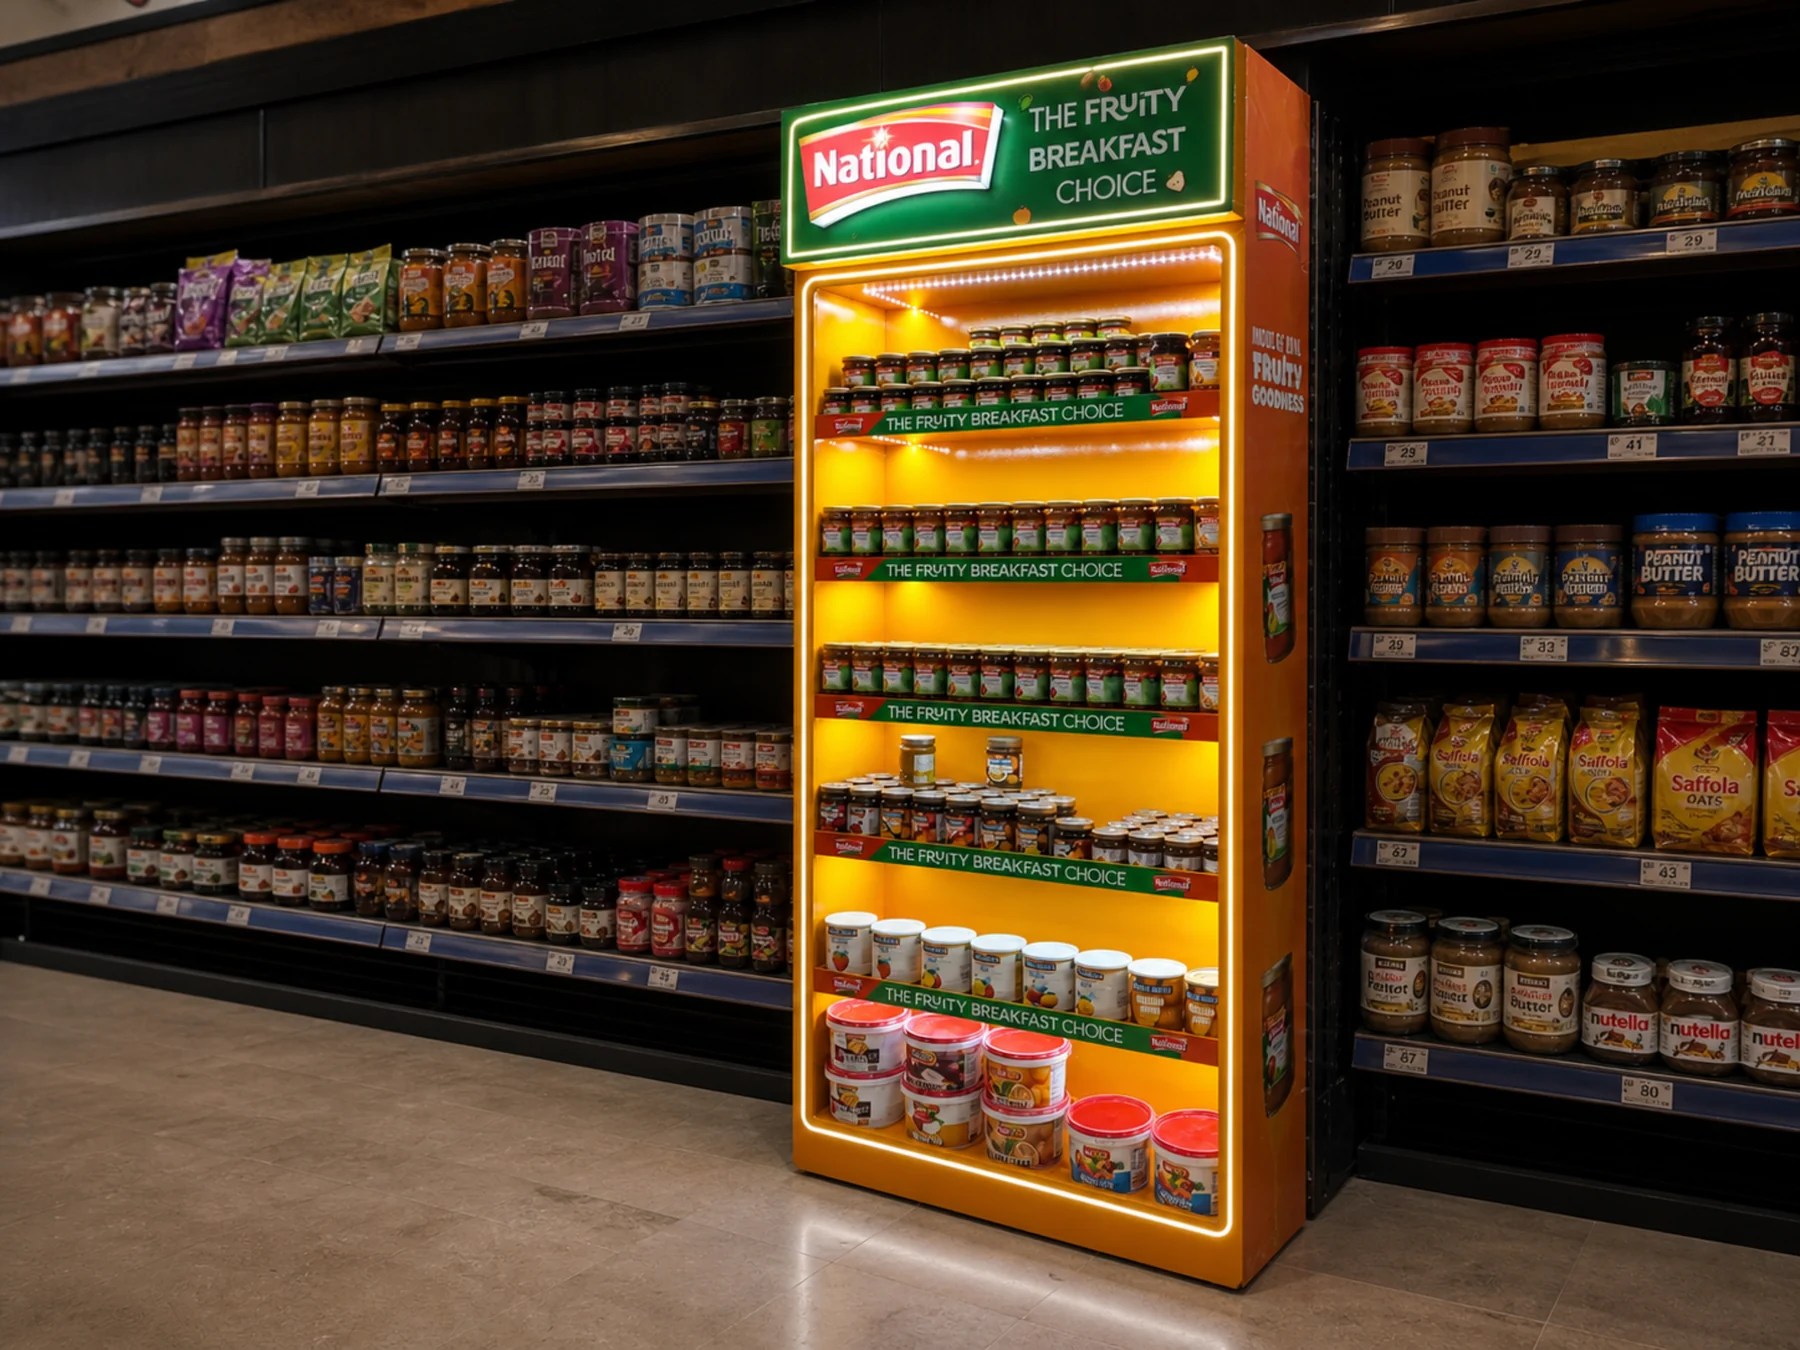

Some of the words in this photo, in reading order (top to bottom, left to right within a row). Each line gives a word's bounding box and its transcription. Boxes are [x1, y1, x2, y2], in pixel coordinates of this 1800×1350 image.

[1029, 101, 1077, 133] THE
[1029, 126, 1186, 172] BREAKFAST
[1056, 169, 1157, 204] CHOICE
[1258, 197, 1299, 243] National
[1252, 384, 1304, 414] GOODNESS
[887, 416, 912, 432] THE
[971, 407, 1058, 426] BREAKFAST
[1062, 402, 1124, 422] CHOICE
[886, 563, 912, 578] THE
[970, 562, 1058, 578] BREAKFAST
[1060, 562, 1122, 578] CHOICE
[1645, 549, 1703, 566] PEANUT
[1641, 566, 1704, 582] BUTTER
[1734, 566, 1800, 582] BUTTER
[887, 704, 914, 720] THE
[971, 708, 1060, 728] BREAKFAST
[1063, 714, 1125, 732] CHOICE
[1671, 775, 1739, 795] Saffola
[1686, 793, 1723, 806] OATS
[888, 845, 915, 862] THE
[973, 854, 1062, 879] BREAKFAST
[1064, 865, 1127, 887] CHOICE
[885, 986, 912, 1004] THE
[971, 1002, 1059, 1032] BREAKFAST
[1061, 1019, 1124, 1044] CHOICE
[1591, 1012, 1649, 1032] nutella
[1670, 1021, 1731, 1041] nutella
